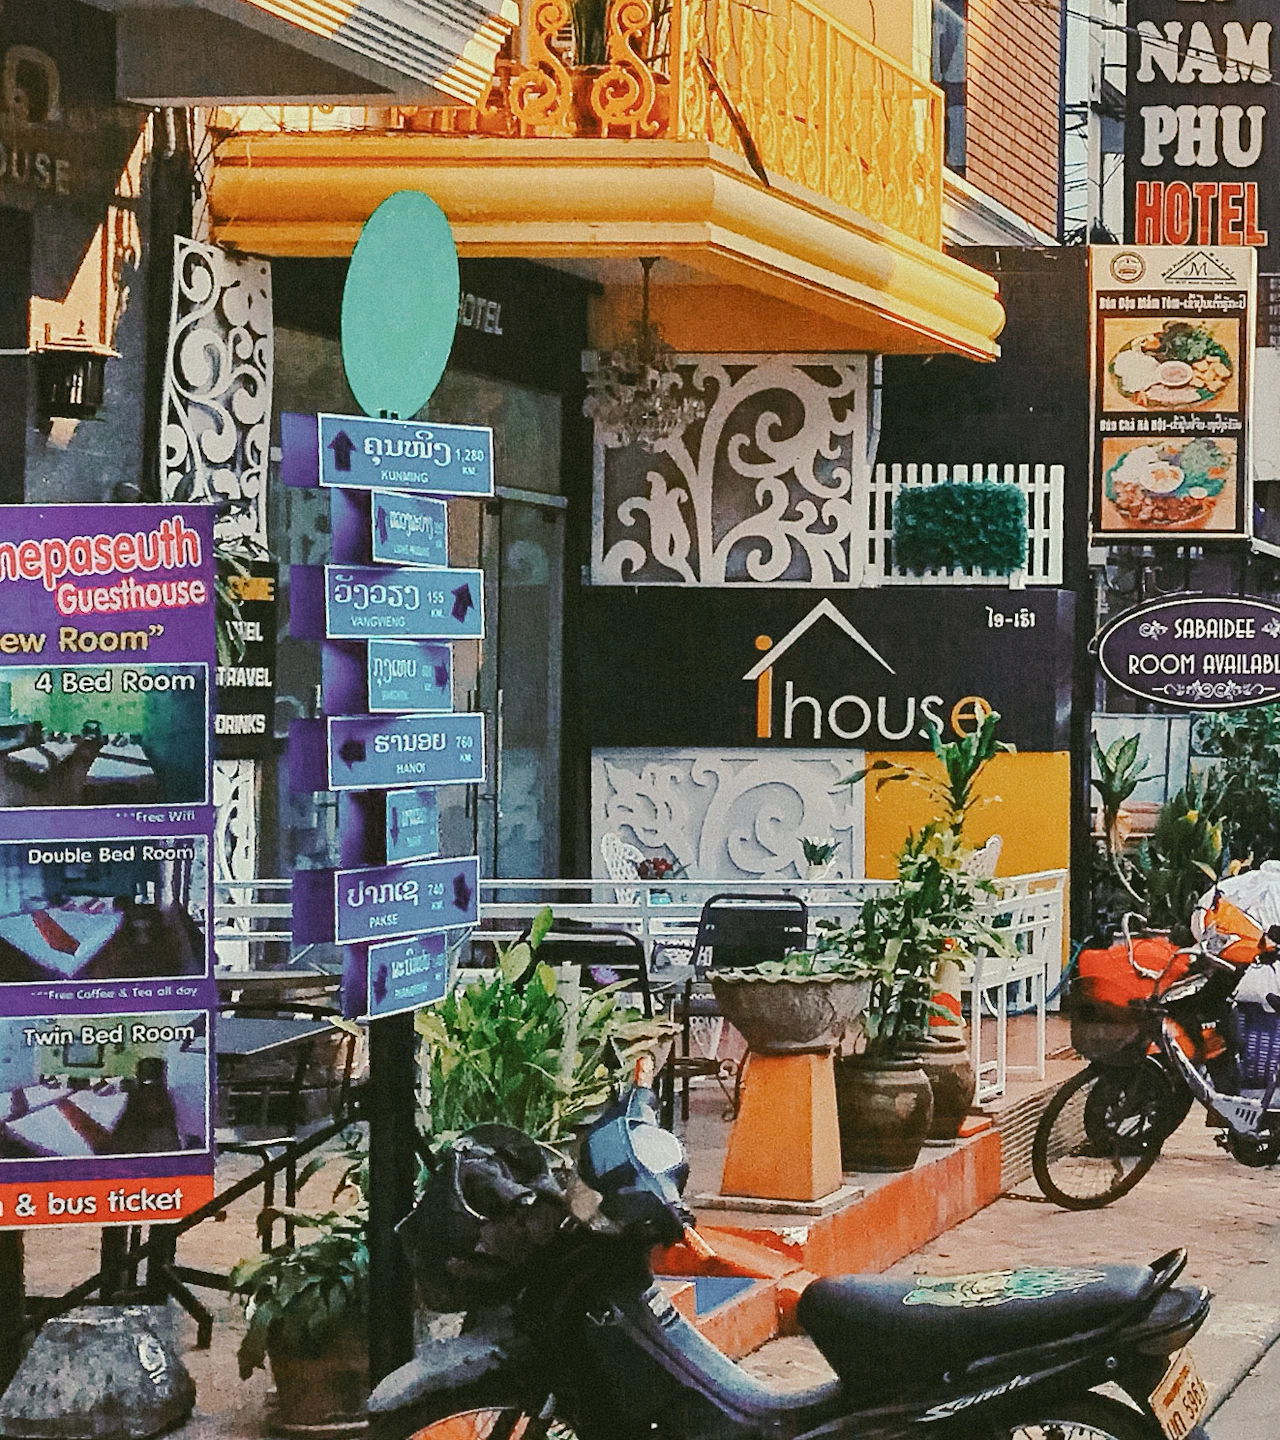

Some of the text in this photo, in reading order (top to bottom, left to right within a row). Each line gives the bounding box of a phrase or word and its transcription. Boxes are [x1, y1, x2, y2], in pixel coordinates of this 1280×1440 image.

[1136, 20, 1273, 84] NAM
[1140, 105, 1266, 167] PHU
[1134, 181, 1268, 247] HOTEL
[381, 469, 429, 483] KUNMING
[57, 577, 206, 615] Guesthouse
[427, 591, 445, 604] 155
[350, 615, 406, 628] VANGVIENG
[1173, 617, 1256, 640] SABAIDEE
[1127, 653, 1195, 675] ROOM
[35, 671, 196, 693] 4 Bed Room
[455, 736, 473, 749] 760
[396, 762, 426, 774] HANOI
[168, 810, 195, 823] Wifi
[28, 846, 195, 864] Double Bed Room
[369, 913, 400, 928] PAKSE
[77, 989, 115, 1000] Coffee
[118, 988, 128, 999] &
[132, 987, 153, 998] Tea
[157, 986, 172, 997] all
[176, 986, 198, 997] day
[24, 1025, 195, 1046] Twin Bed Room
[15, 1188, 184, 1217] & bus ticket
